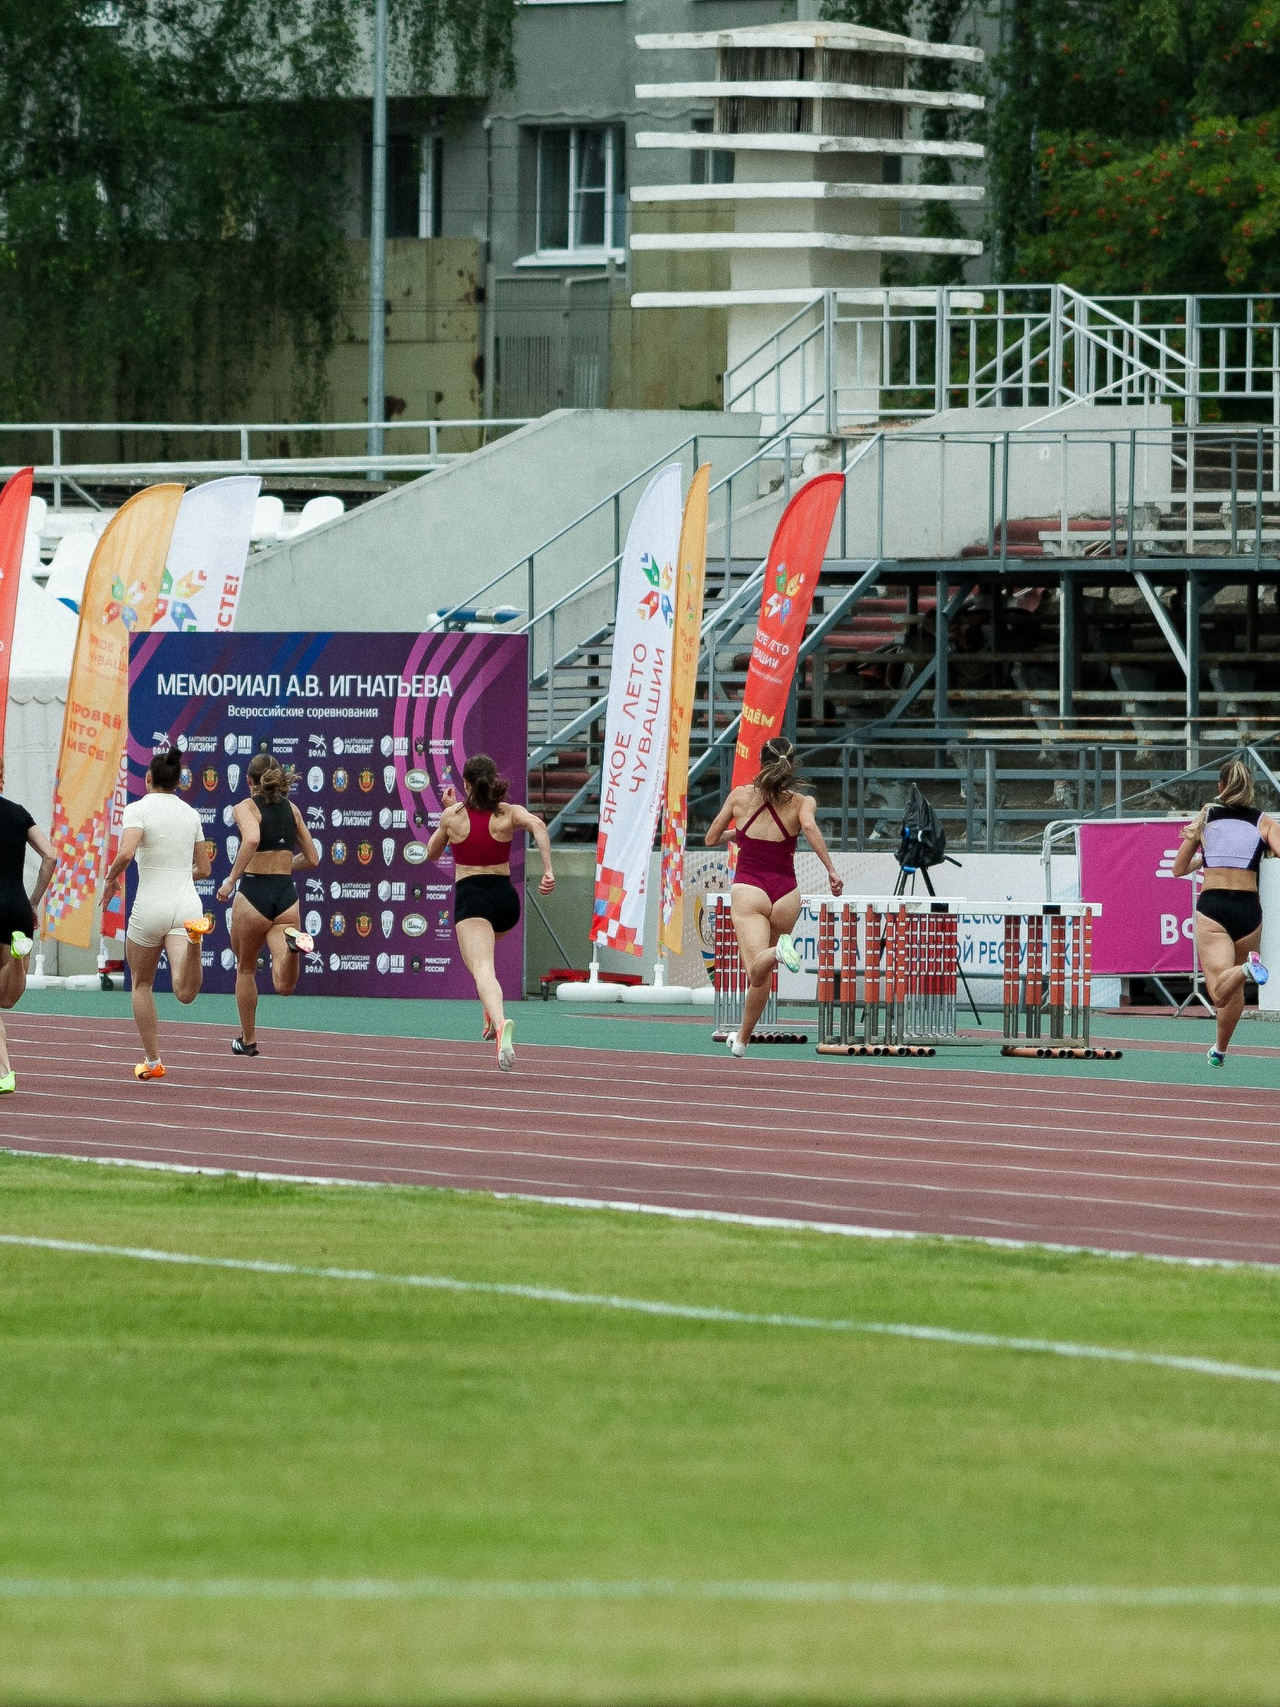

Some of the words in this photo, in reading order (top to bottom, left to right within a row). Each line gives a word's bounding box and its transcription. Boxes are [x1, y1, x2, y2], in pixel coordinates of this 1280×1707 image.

[157, 673, 280, 697] МЕМОРИАЛ
[286, 674, 323, 697] А.В.
[329, 674, 453, 698] ИГНАТЬЕВА
[227, 704, 304, 719] Всероссийские
[306, 707, 378, 720] соревнования
[629, 648, 665, 793] ЧУВАШИИ
[603, 731, 632, 825] ЯРКОЕ
[622, 643, 647, 720] ЛЕТО
[187, 742, 217, 752] ЛИЗИНГ
[344, 744, 373, 754] ЛИЗИНГ
[308, 749, 326, 757] ВФЛА
[343, 815, 372, 826] ЛИЗИНГ
[306, 894, 324, 902] ВФЛА
[341, 888, 370, 898] ЛИЗИНГ
[305, 965, 323, 973] ВФЛА
[340, 961, 370, 971] ЛИЗИНГ
